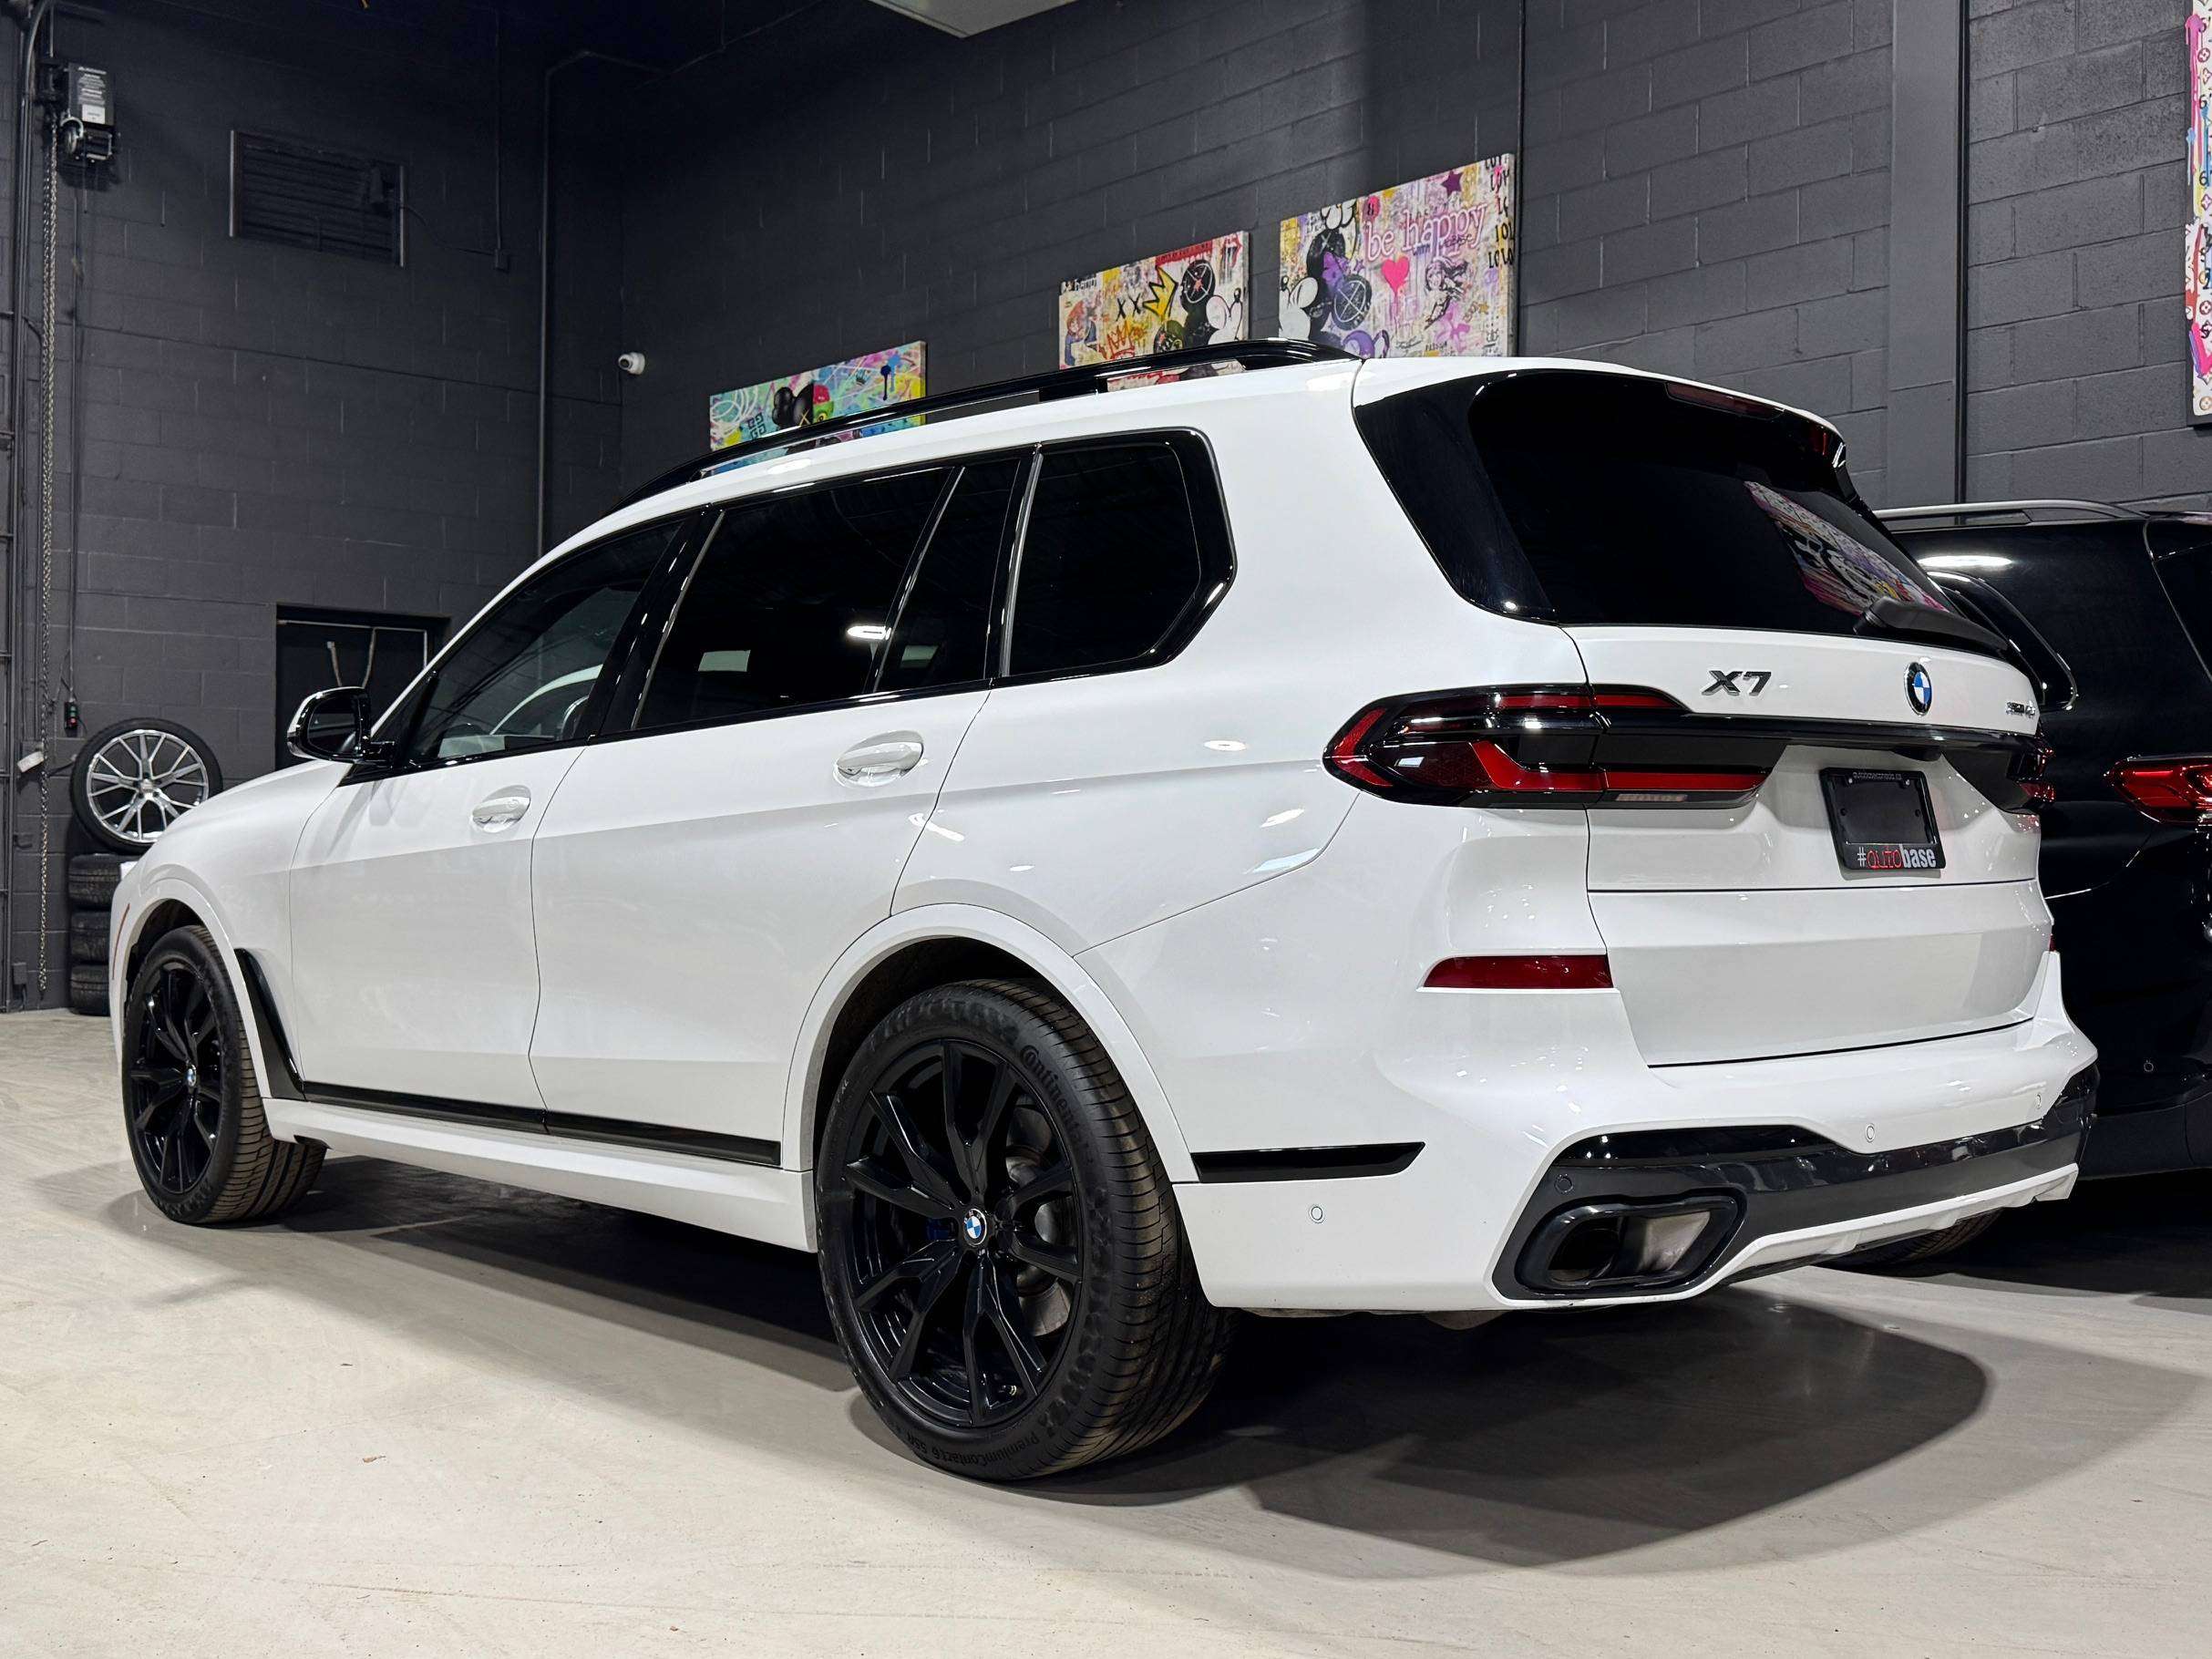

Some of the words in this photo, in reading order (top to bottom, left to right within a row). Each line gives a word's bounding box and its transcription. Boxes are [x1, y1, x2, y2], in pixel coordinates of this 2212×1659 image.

[1363, 220, 1396, 263] be
[1401, 201, 1488, 256] happy
[1702, 669, 1772, 697] X7
[1857, 843, 1937, 870] #autobase
